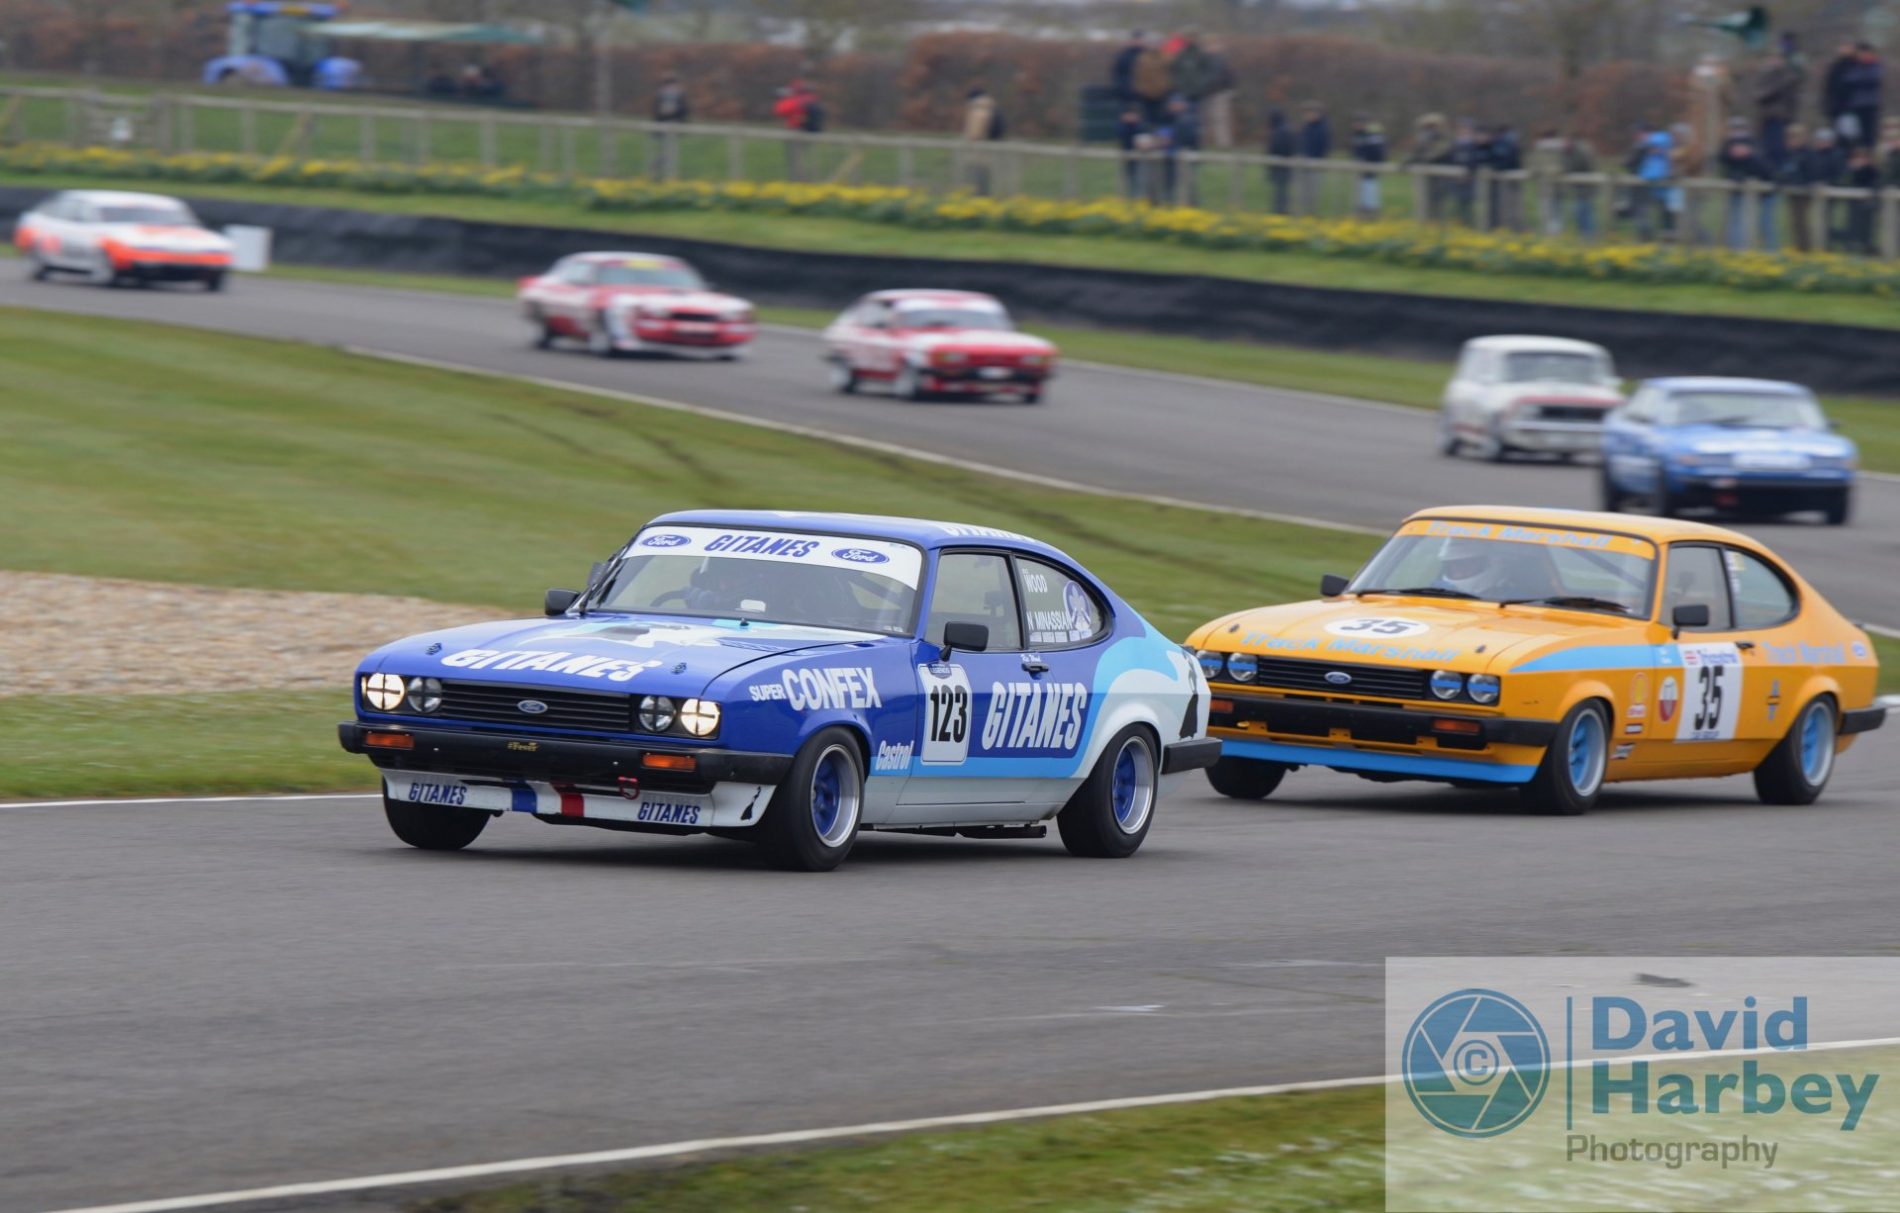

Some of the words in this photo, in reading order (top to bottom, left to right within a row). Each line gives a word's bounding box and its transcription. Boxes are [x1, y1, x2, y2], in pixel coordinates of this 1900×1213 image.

[645, 534, 682, 547] Ford
[704, 534, 820, 558] GITANES
[840, 548, 882, 563] Ford
[1023, 574, 1048, 593] WOOD
[1340, 618, 1419, 635] 35
[1241, 632, 1319, 650] Track
[1327, 637, 1463, 662] Marshall
[441, 648, 663, 682] GITANES
[749, 683, 787, 702] SUPER
[781, 667, 882, 711] CONFEX
[1694, 665, 1724, 731] 35
[930, 684, 968, 743] 123
[982, 682, 1087, 750] GITANES
[875, 740, 914, 771] Castrol
[408, 782, 467, 805] GITANES
[637, 801, 701, 825] GITANES
